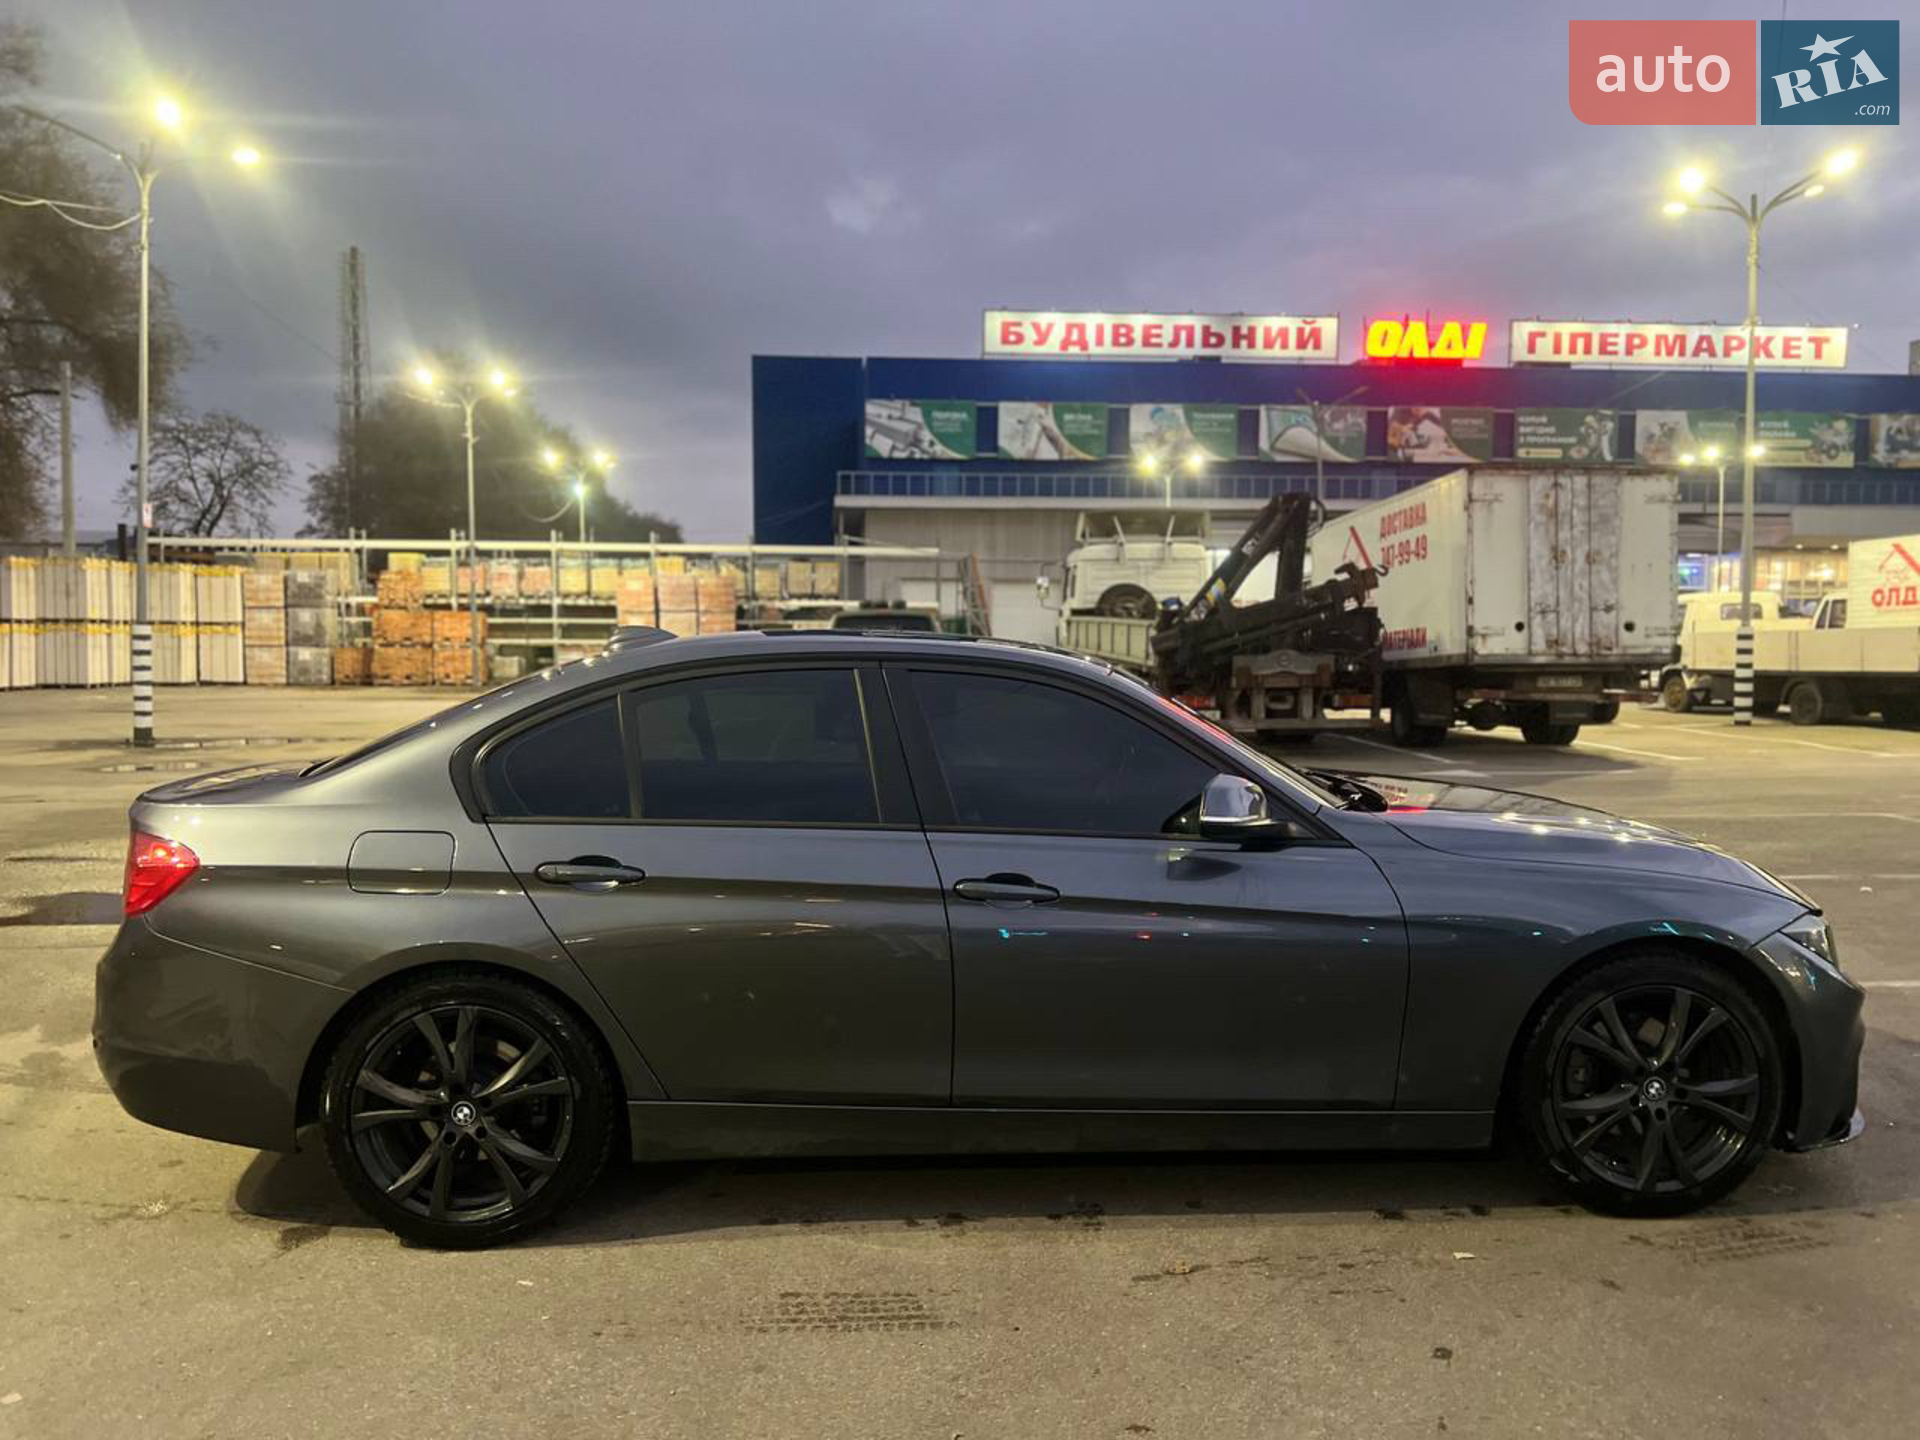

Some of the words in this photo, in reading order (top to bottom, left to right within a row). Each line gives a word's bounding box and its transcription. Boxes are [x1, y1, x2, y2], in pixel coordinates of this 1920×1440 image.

[1000, 319, 1323, 352] БУДІВЕЛЬНИЙ
[1365, 319, 1487, 359] ОЛДІ
[1526, 331, 1831, 361] ГІПЕРМАРКЕТ
[1380, 501, 1427, 542] ДОСТАВКА
